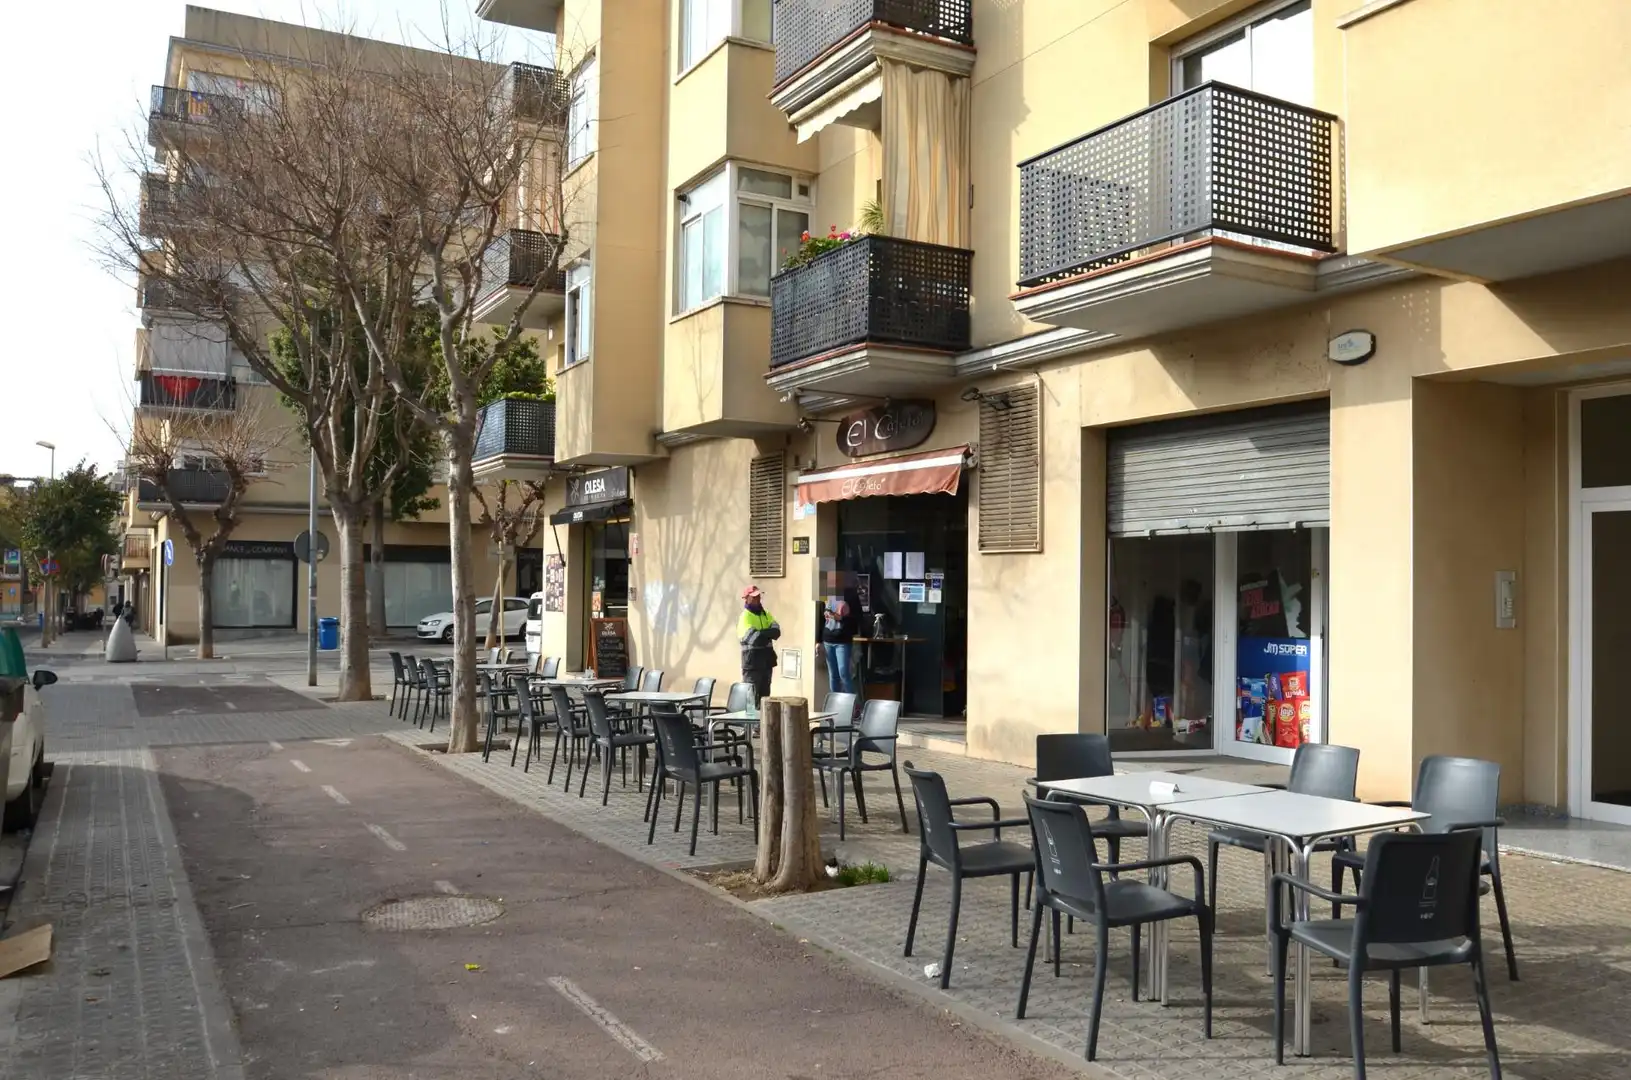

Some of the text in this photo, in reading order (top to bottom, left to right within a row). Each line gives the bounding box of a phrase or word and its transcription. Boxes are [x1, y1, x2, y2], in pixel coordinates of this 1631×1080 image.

[846, 419, 867, 447] El
[584, 478, 606, 494] OLESA
[841, 479, 854, 496] El
